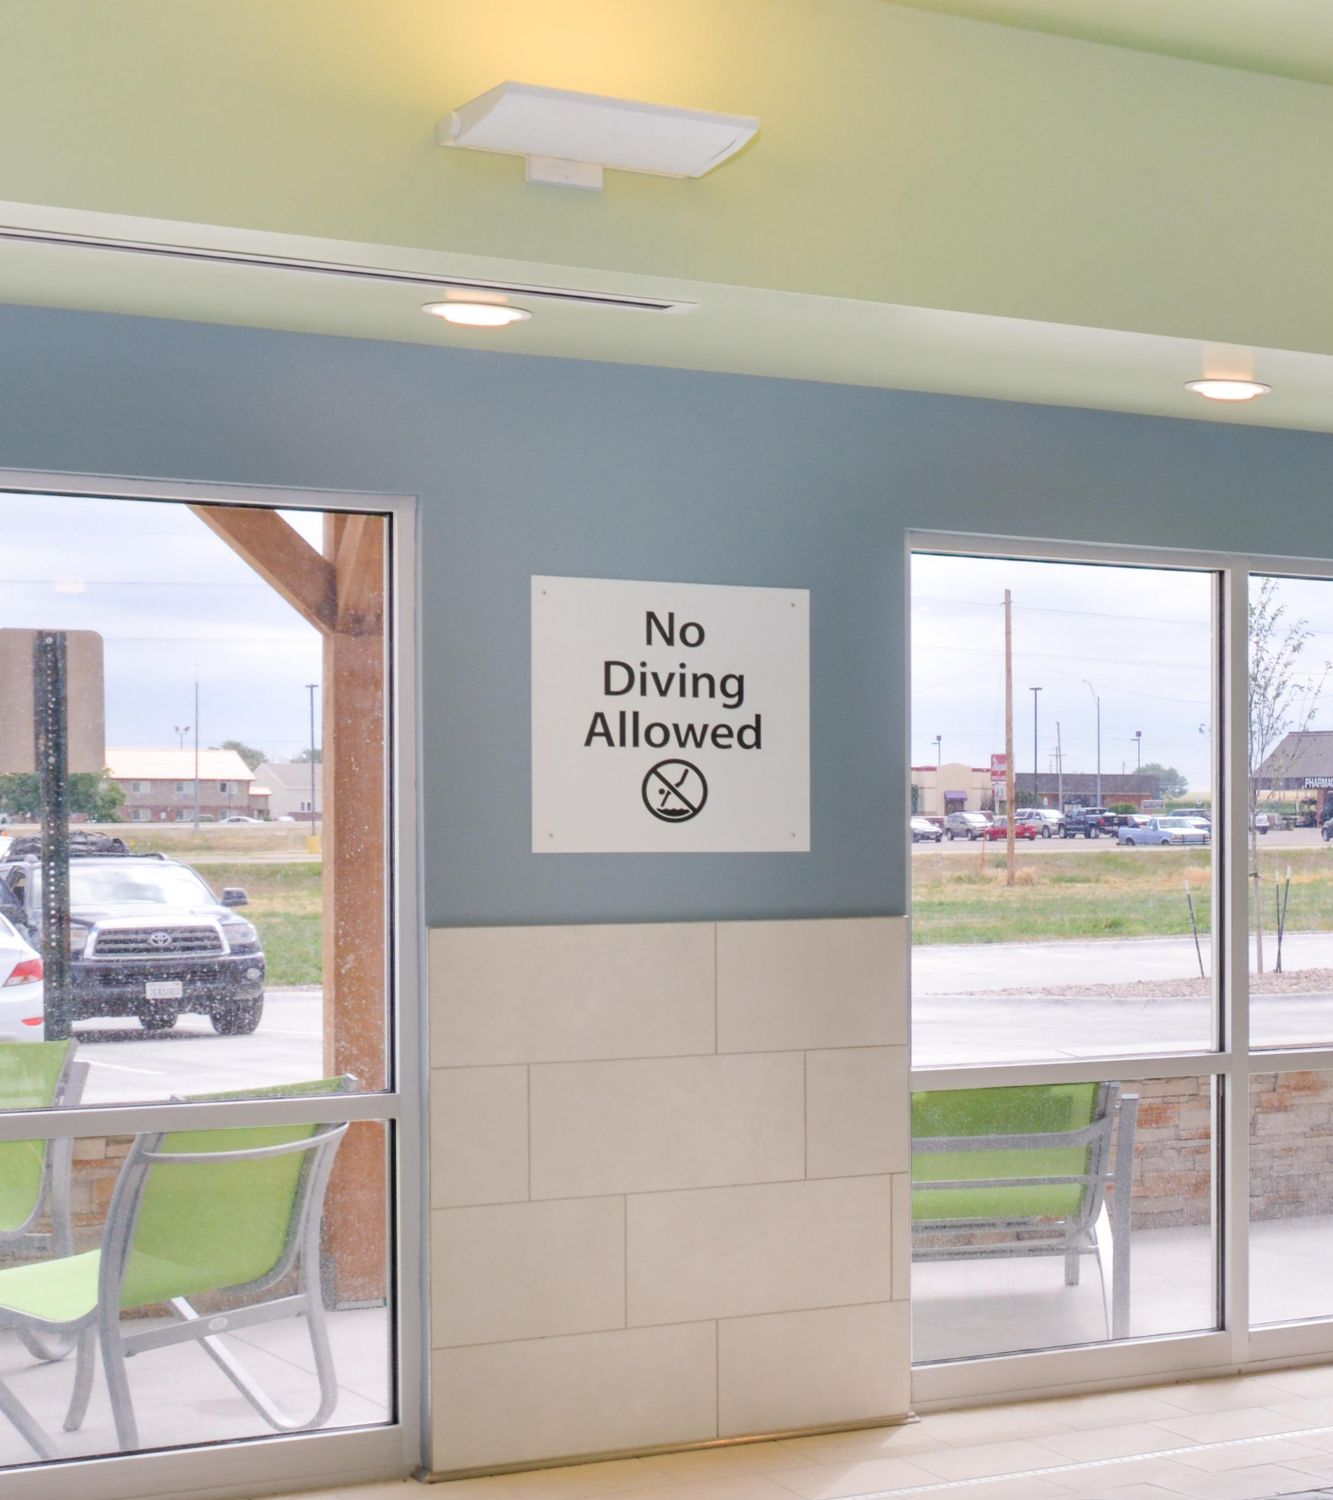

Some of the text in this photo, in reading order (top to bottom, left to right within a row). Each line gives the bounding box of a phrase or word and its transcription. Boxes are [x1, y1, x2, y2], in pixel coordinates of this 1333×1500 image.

[646, 611, 705, 648] No
[604, 660, 744, 710] Diving
[584, 710, 762, 750] Allowed
